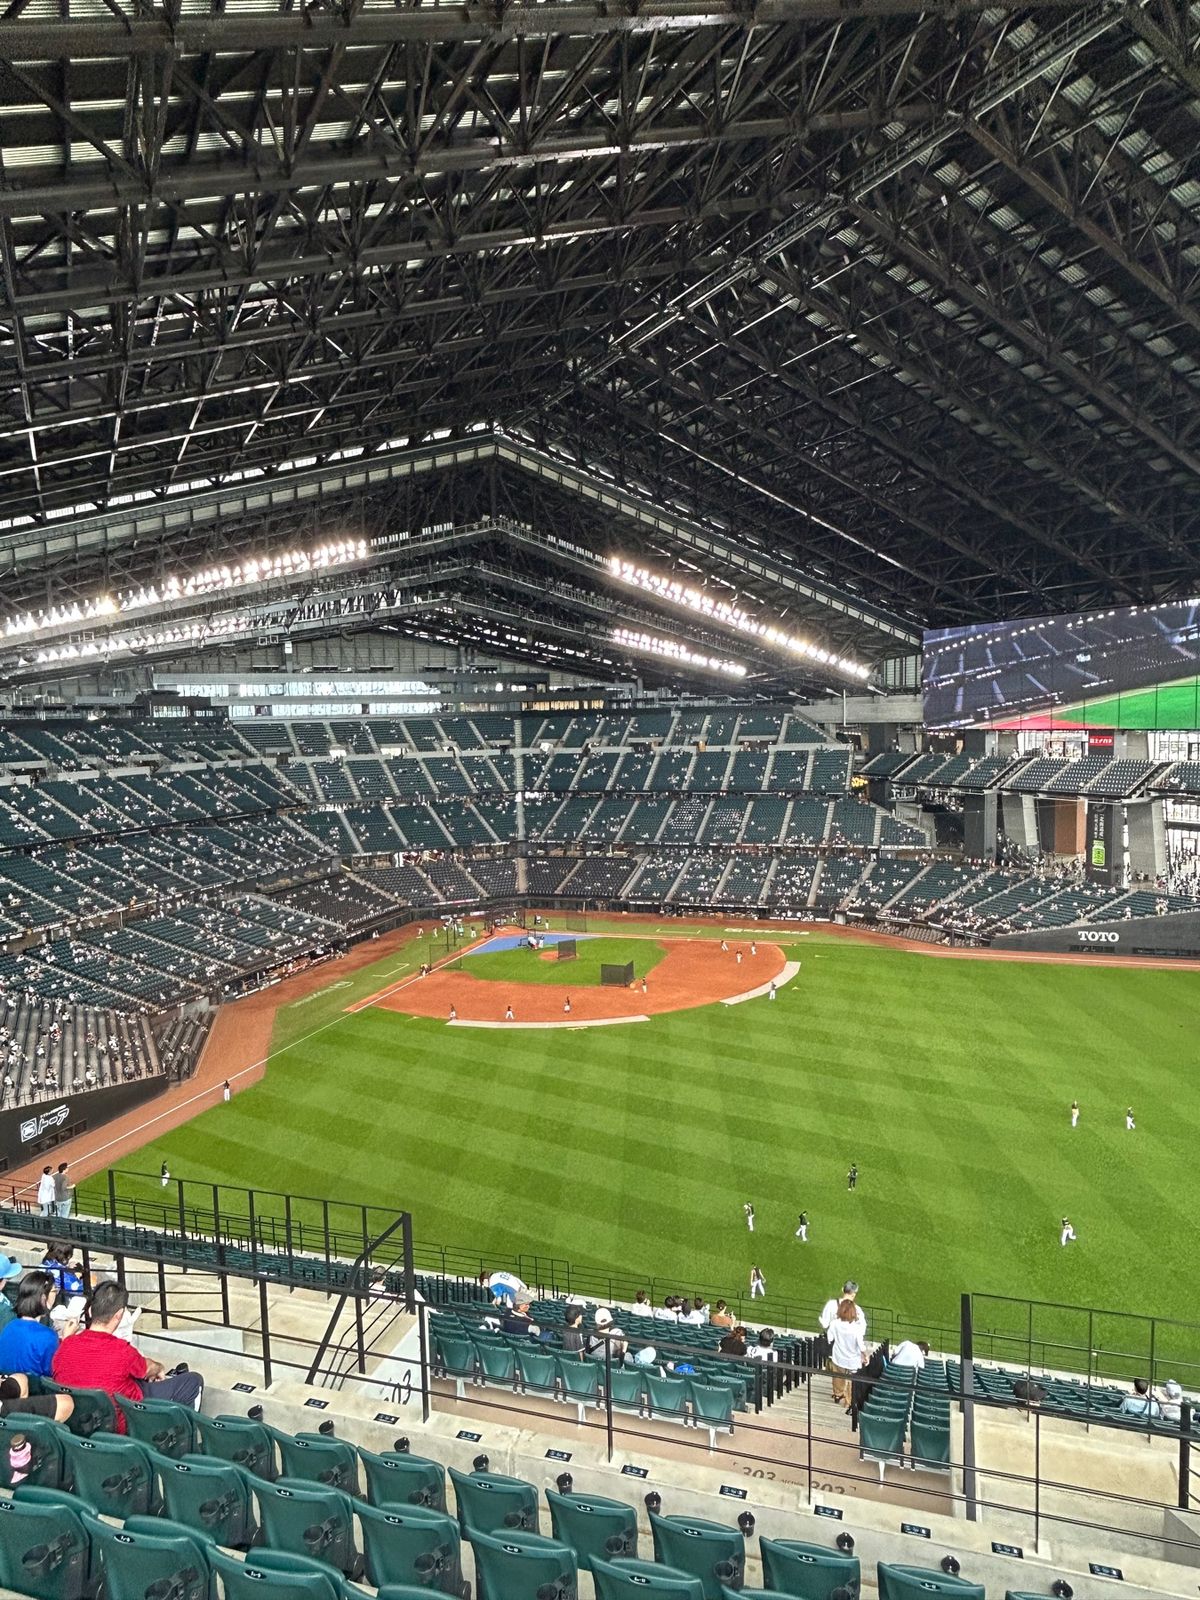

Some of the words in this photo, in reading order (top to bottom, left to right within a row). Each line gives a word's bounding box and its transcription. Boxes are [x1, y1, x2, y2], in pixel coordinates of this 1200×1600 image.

[1077, 931, 1120, 943] TOTO
[38, 1108, 69, 1134] トーア
